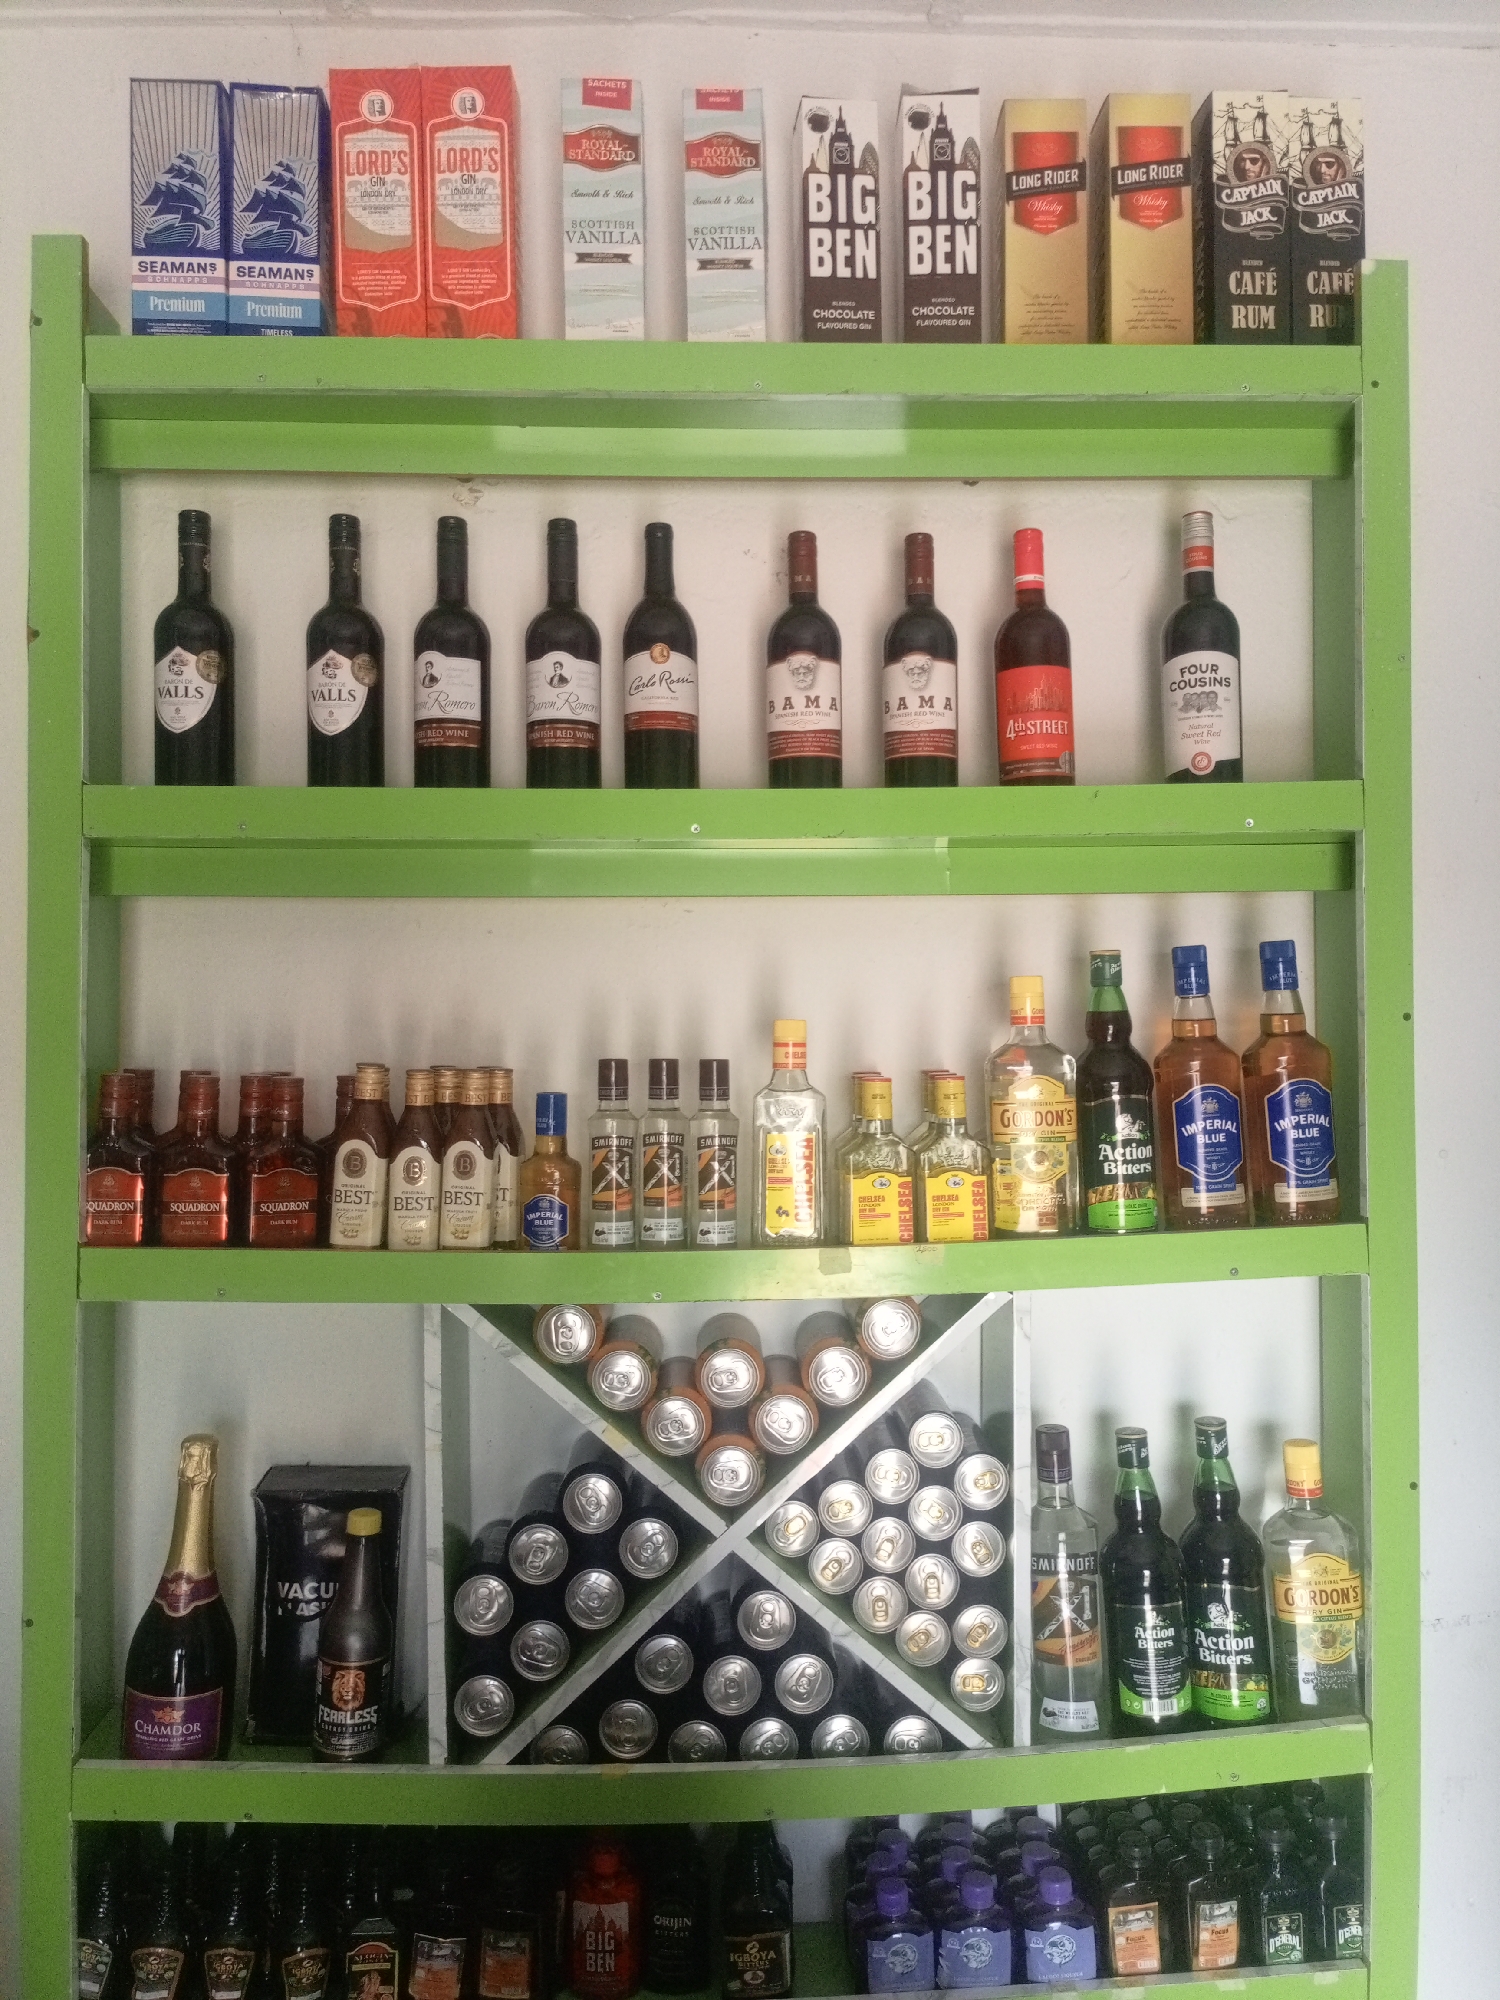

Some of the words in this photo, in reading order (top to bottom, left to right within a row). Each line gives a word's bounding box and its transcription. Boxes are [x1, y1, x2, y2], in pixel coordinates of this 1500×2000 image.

[587, 79, 627, 89] SACHETS
[581, 139, 623, 151] ROYAL
[703, 146, 743, 157] ROYAL
[346, 150, 408, 176] LORD'S
[437, 147, 499, 174] LORD'S
[568, 150, 635, 161] STANDARD
[690, 157, 756, 167] STANDARD
[370, 177, 386, 187] GIN
[461, 174, 476, 184] GIN
[1012, 173, 1041, 191] LONG
[1044, 169, 1079, 185] RIDER
[1117, 167, 1146, 185] LONG
[1149, 164, 1183, 181] RIDER
[571, 190, 600, 198] Smooth
[613, 190, 634, 199] Rich
[808, 173, 876, 224] BIG
[908, 170, 977, 220] BIG
[1221, 179, 1284, 204] CAPTAIN
[1298, 182, 1359, 206] CAPTAIN
[734, 197, 754, 205] Rich
[1027, 197, 1063, 214] Whisky
[1133, 193, 1168, 210] Whisky
[571, 220, 634, 230] SCOTTISH
[1240, 207, 1278, 227] JACK
[1317, 209, 1353, 228] JACK
[565, 231, 642, 244] VANILLA
[694, 226, 755, 235] SCOTTISH
[688, 237, 763, 250] VANILLA
[909, 225, 977, 275] BEN
[809, 228, 877, 279] BEN
[147, 276, 208, 284] SCHNAPPS
[1229, 267, 1278, 296] CAFÉ
[1307, 268, 1354, 295] CAFÉ
[149, 296, 206, 312] Premium
[247, 302, 302, 318] Premium
[912, 306, 975, 316] CHOCOLATE
[813, 309, 875, 320] CHOCOLATE
[1231, 305, 1276, 329] RUM
[817, 322, 857, 330] FLAVOURED
[1180, 664, 1219, 678] FOUR
[629, 673, 656, 696] Carlo
[659, 670, 694, 693] Rossi
[1170, 677, 1231, 692] COUSINS
[158, 686, 204, 699] VALLS
[311, 689, 357, 702] VALLS
[428, 690, 476, 714] Romero
[526, 694, 555, 717] Baron
[889, 712, 912, 720] SPANISH
[575, 731, 595, 740] WINE
[1006, 718, 1025, 740] 4th
[1027, 720, 1068, 735] STREET
[1181, 731, 1204, 740] Sweet
[1207, 729, 1221, 737] Red
[356, 1088, 377, 1097] BEST
[1000, 1109, 1074, 1129] GORDON'S
[1274, 1114, 1330, 1132] IMPERIAL
[1181, 1119, 1237, 1137] IMPERIAL
[1291, 1128, 1319, 1139] BLUE
[594, 1138, 632, 1147] SMIRNOFF
[645, 1134, 683, 1144] SMIRNOFF
[700, 1137, 737, 1145] SMIRNOFF
[1196, 1133, 1227, 1144] BLUE
[1099, 1143, 1153, 1161] Action
[1103, 1162, 1151, 1175] Bitters
[333, 1189, 373, 1205] BEST
[393, 1196, 435, 1212] BEST
[443, 1190, 484, 1206] BEST
[858, 1195, 885, 1203] CHELSEA
[932, 1194, 959, 1202] CHELSEA
[170, 1202, 220, 1212] SQUADRON
[259, 1201, 309, 1212] SQUADRON
[898, 1180, 913, 1243] CHELSEA
[972, 1180, 989, 1241] CHELSEA
[527, 1212, 563, 1220] IMPERIAL
[277, 1582, 339, 1599] VACU
[1284, 1584, 1360, 1607] GORDON'S
[1134, 1625, 1175, 1638] Action
[1194, 1628, 1255, 1650] Action
[1138, 1639, 1174, 1649] Bitters
[1200, 1647, 1253, 1665] Bitters
[319, 1704, 378, 1724] FEARLESS
[134, 1719, 202, 1735] CHAMDOR
[321, 1723, 346, 1732] ENERGY
[349, 1724, 371, 1732] DRINK
[653, 1914, 692, 1930] ORIJIN
[586, 1931, 615, 1950] BIG
[1269, 1934, 1301, 1953] D'GENERAL
[586, 1953, 615, 1974] BEN
[729, 1951, 776, 1962] IGBOYA
